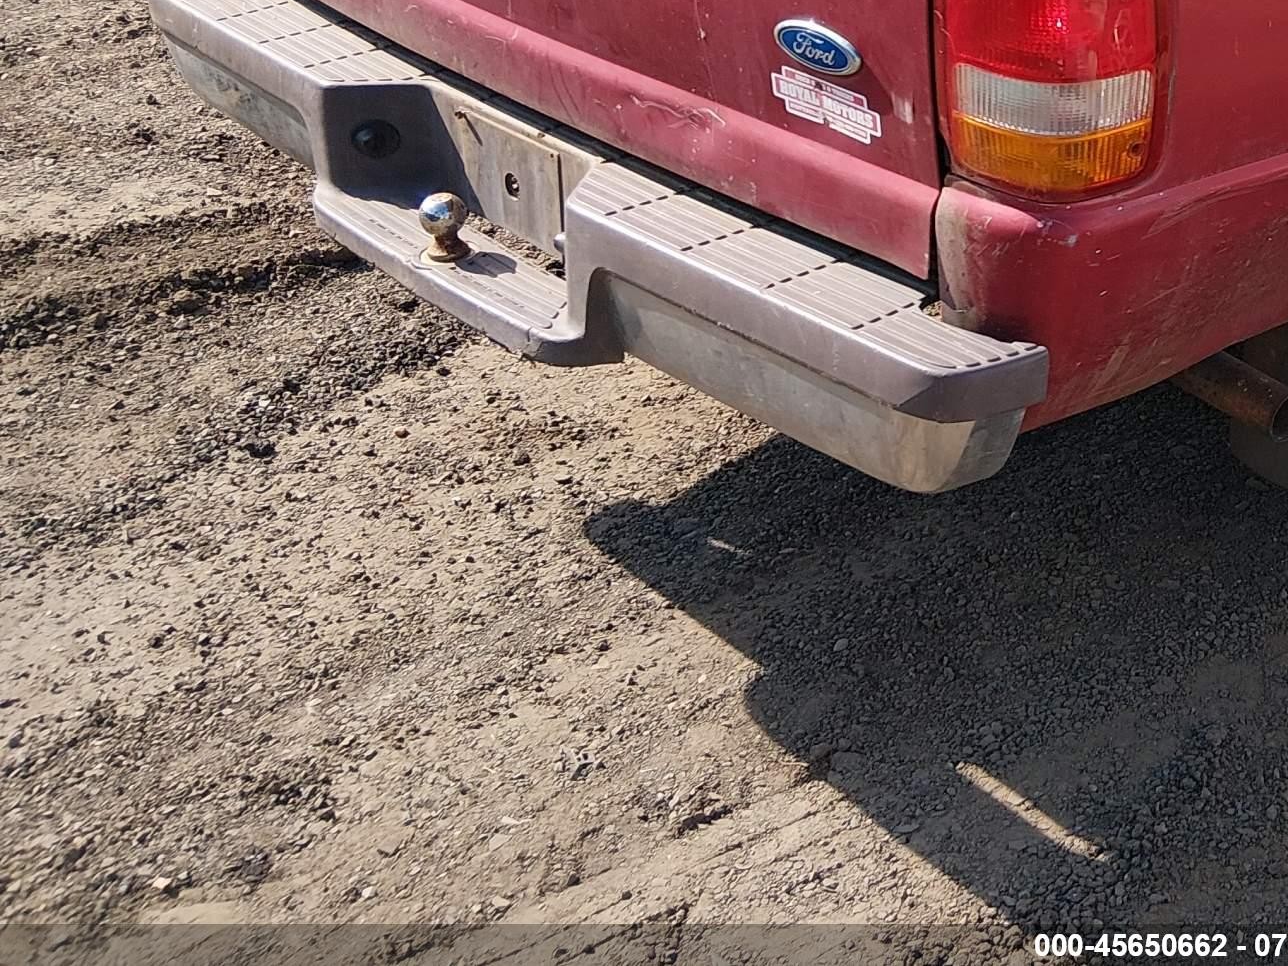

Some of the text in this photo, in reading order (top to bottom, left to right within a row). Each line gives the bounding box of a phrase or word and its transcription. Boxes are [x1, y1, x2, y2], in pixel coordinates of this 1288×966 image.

[792, 32, 837, 65] Ford
[780, 79, 820, 107] ROYAL
[823, 95, 874, 128] MOTORS
